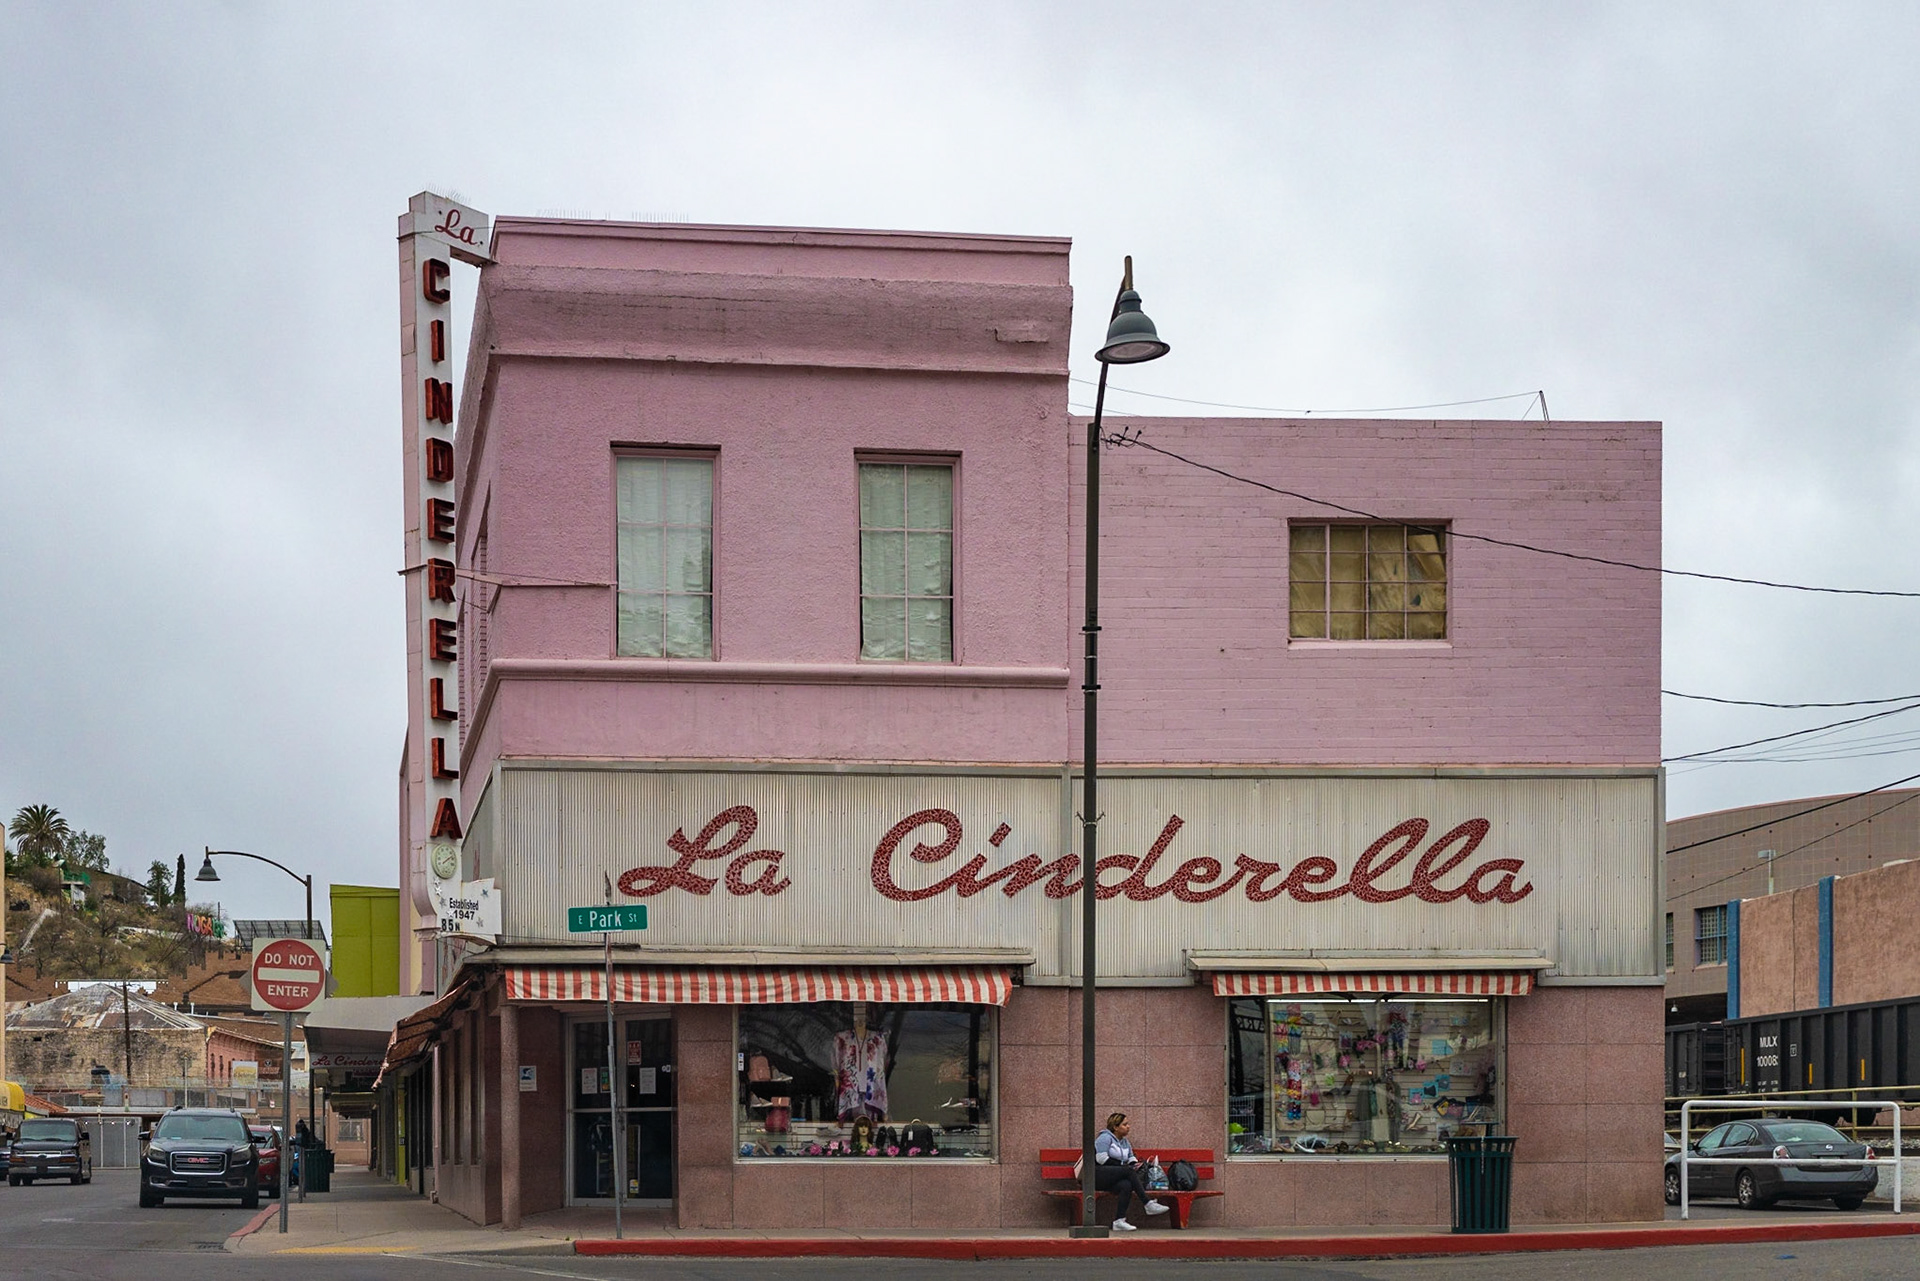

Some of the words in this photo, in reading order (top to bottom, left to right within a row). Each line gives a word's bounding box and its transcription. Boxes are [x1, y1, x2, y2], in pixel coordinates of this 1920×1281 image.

[434, 208, 478, 246] La
[422, 257, 464, 841] CINDERELLA
[617, 804, 792, 898] La
[870, 808, 1534, 904] Cinderella
[449, 897, 479, 911] Established
[453, 909, 475, 921] 1947
[578, 914, 583, 925] E
[589, 910, 622, 928] Park
[628, 913, 637, 923] St
[441, 918, 454, 931] 85
[455, 922, 461, 931] N
[264, 952, 282, 965] DO
[289, 954, 315, 966] NOT
[267, 984, 309, 998] ENTER
[1759, 1035, 1779, 1048] MULX
[311, 1055, 331, 1066] La
